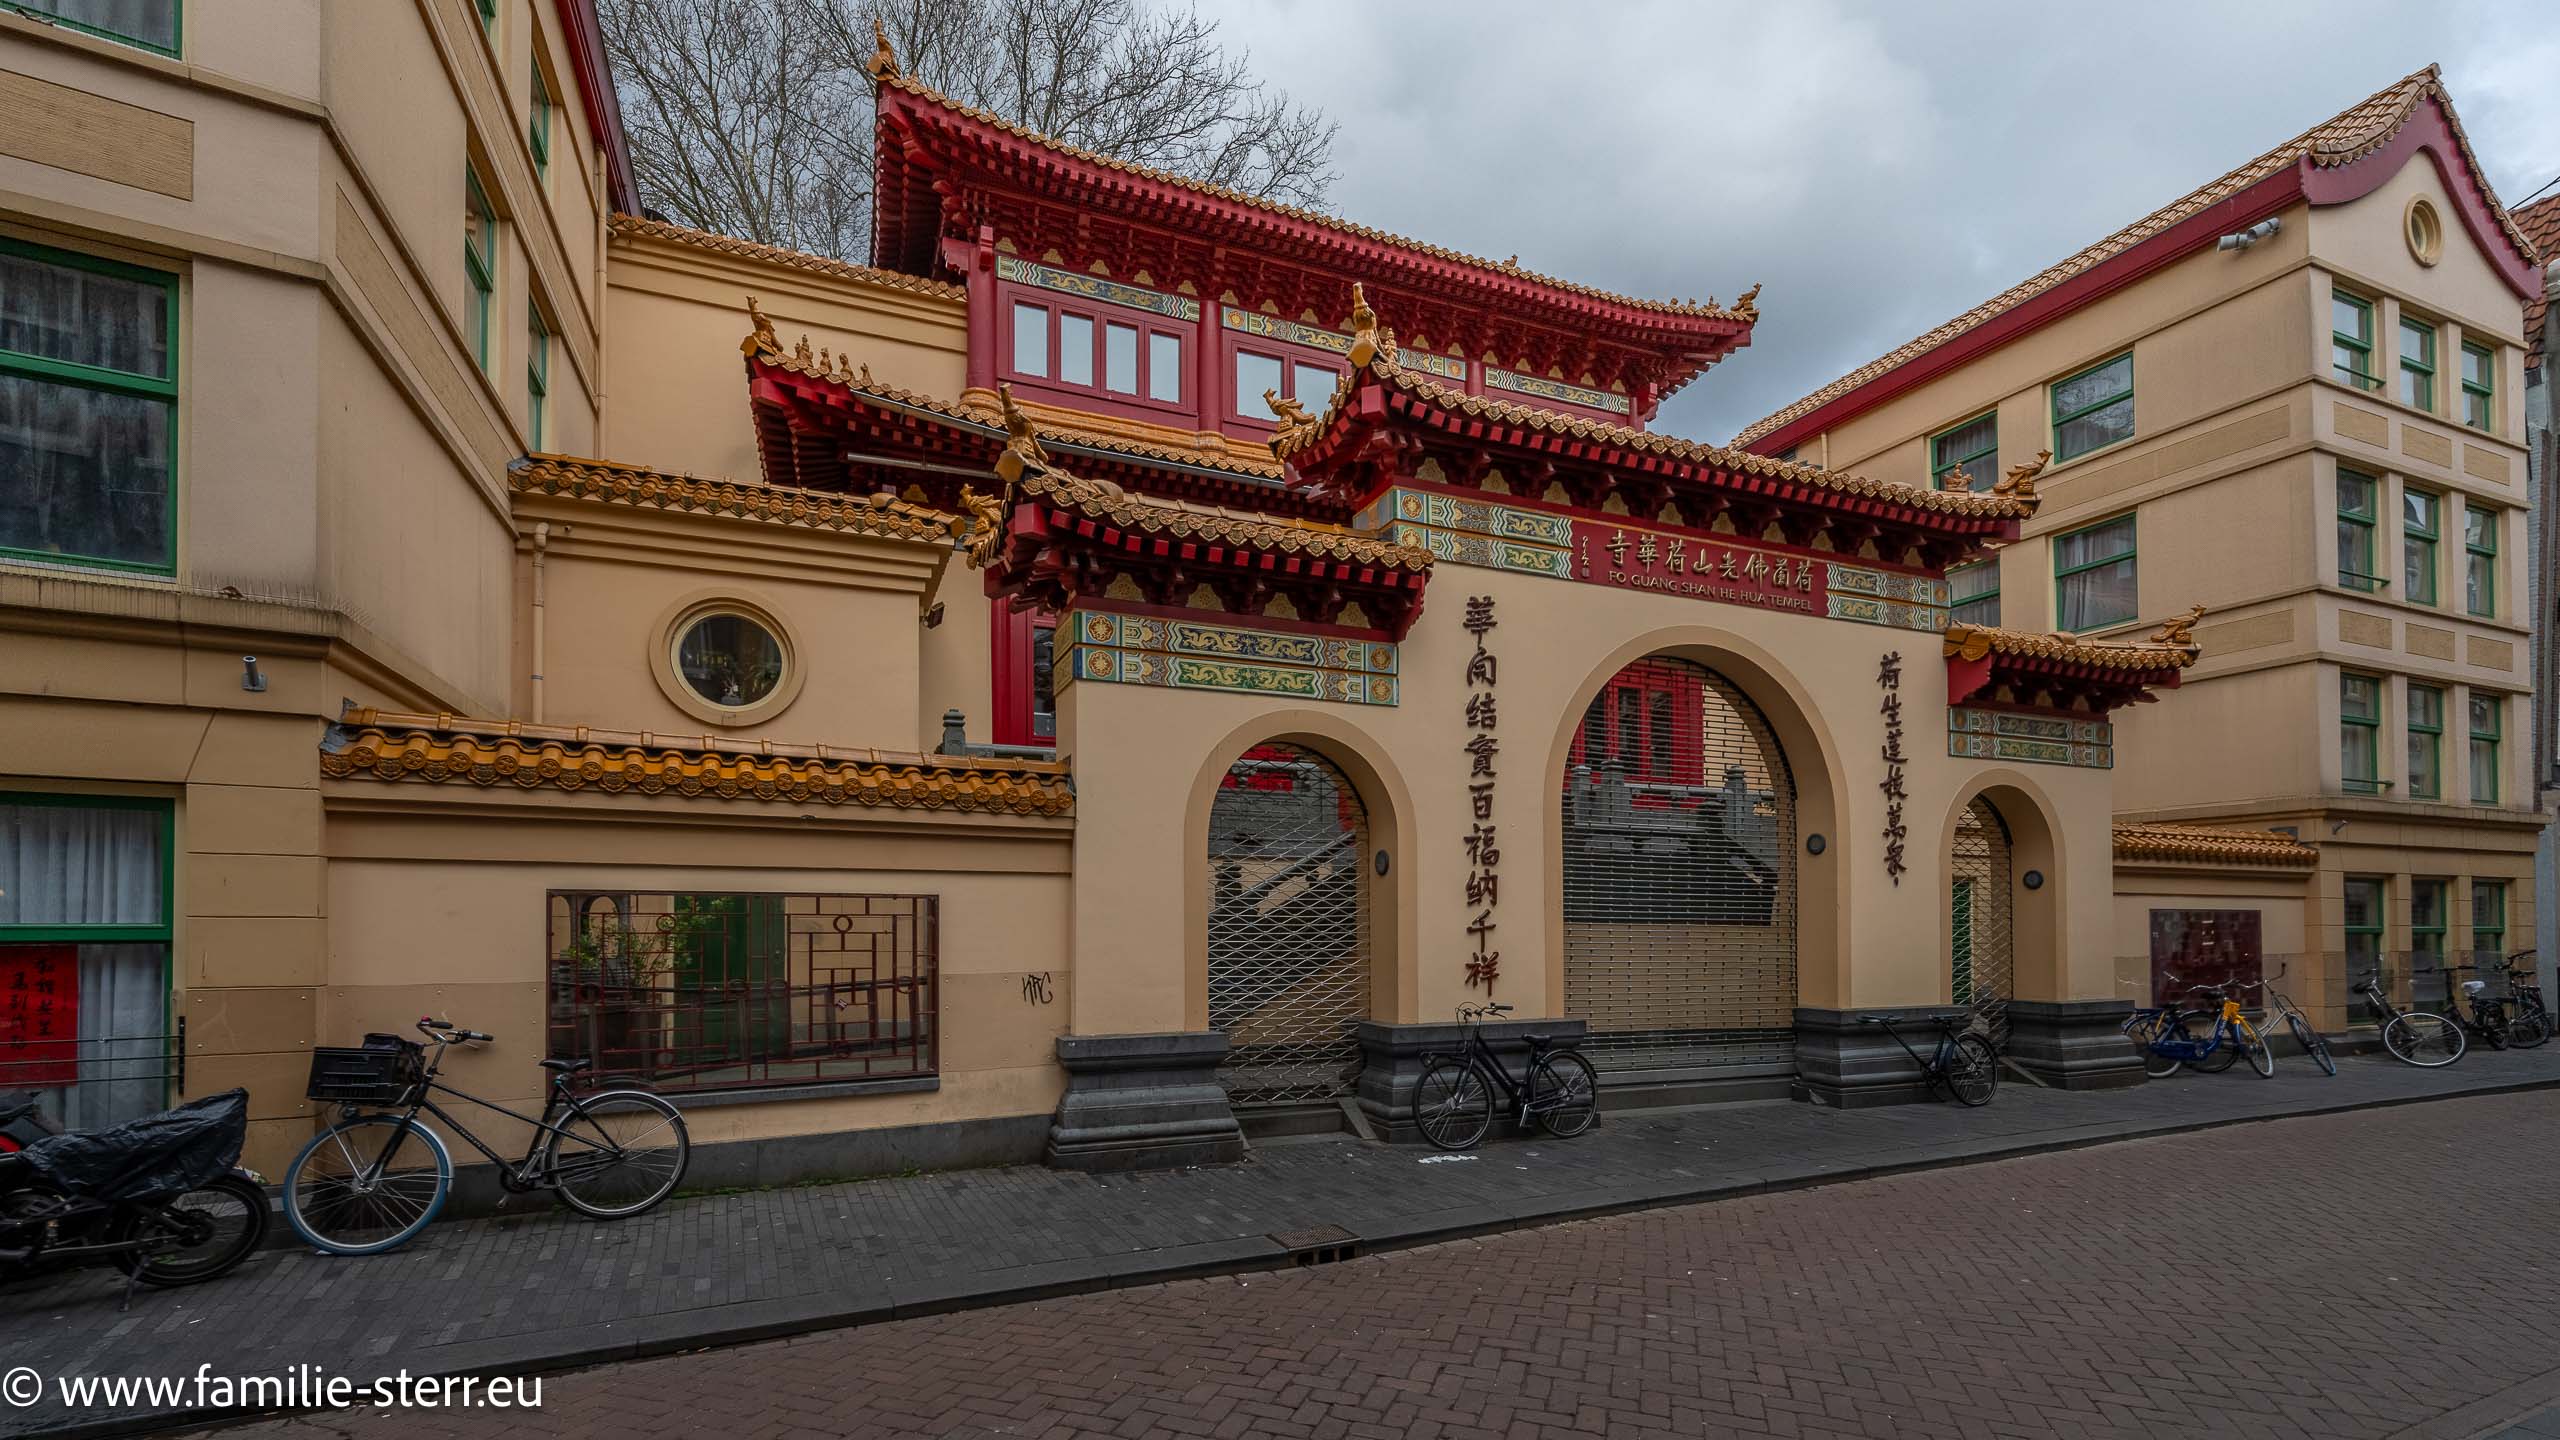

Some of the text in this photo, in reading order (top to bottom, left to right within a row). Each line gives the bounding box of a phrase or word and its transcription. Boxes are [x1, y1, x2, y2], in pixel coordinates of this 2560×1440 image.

[1609, 570, 1814, 611] FO GUANG SHAN HE HUA TEMPEL
